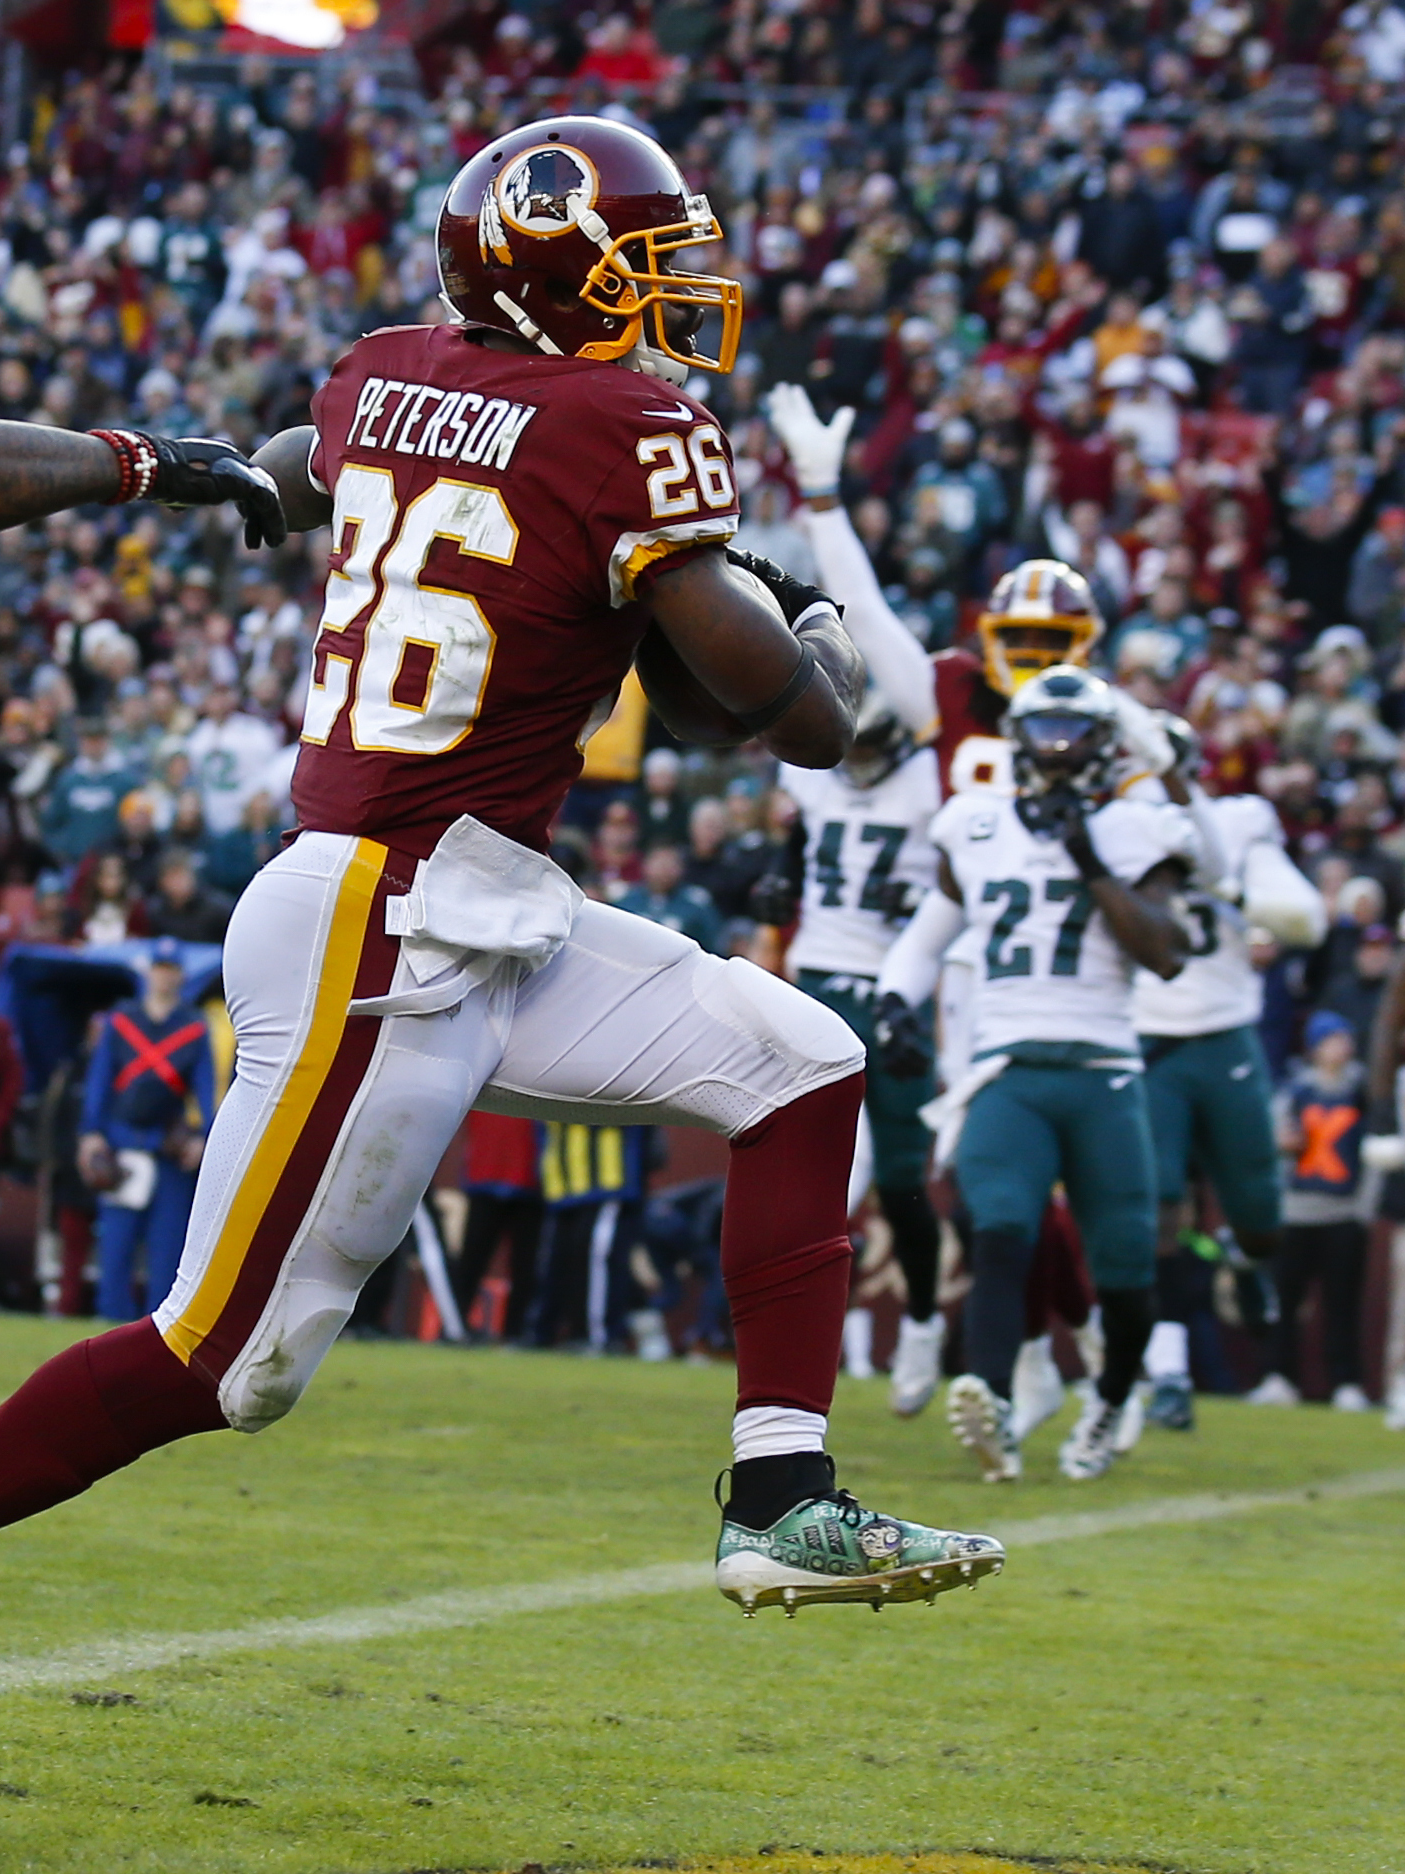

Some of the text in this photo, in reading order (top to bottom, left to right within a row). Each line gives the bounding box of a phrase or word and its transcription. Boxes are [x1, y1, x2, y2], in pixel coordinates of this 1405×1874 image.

[346, 377, 538, 471] PETERSON
[636, 423, 735, 519] 26
[300, 463, 520, 755] 26
[980, 879, 1094, 981] 27
